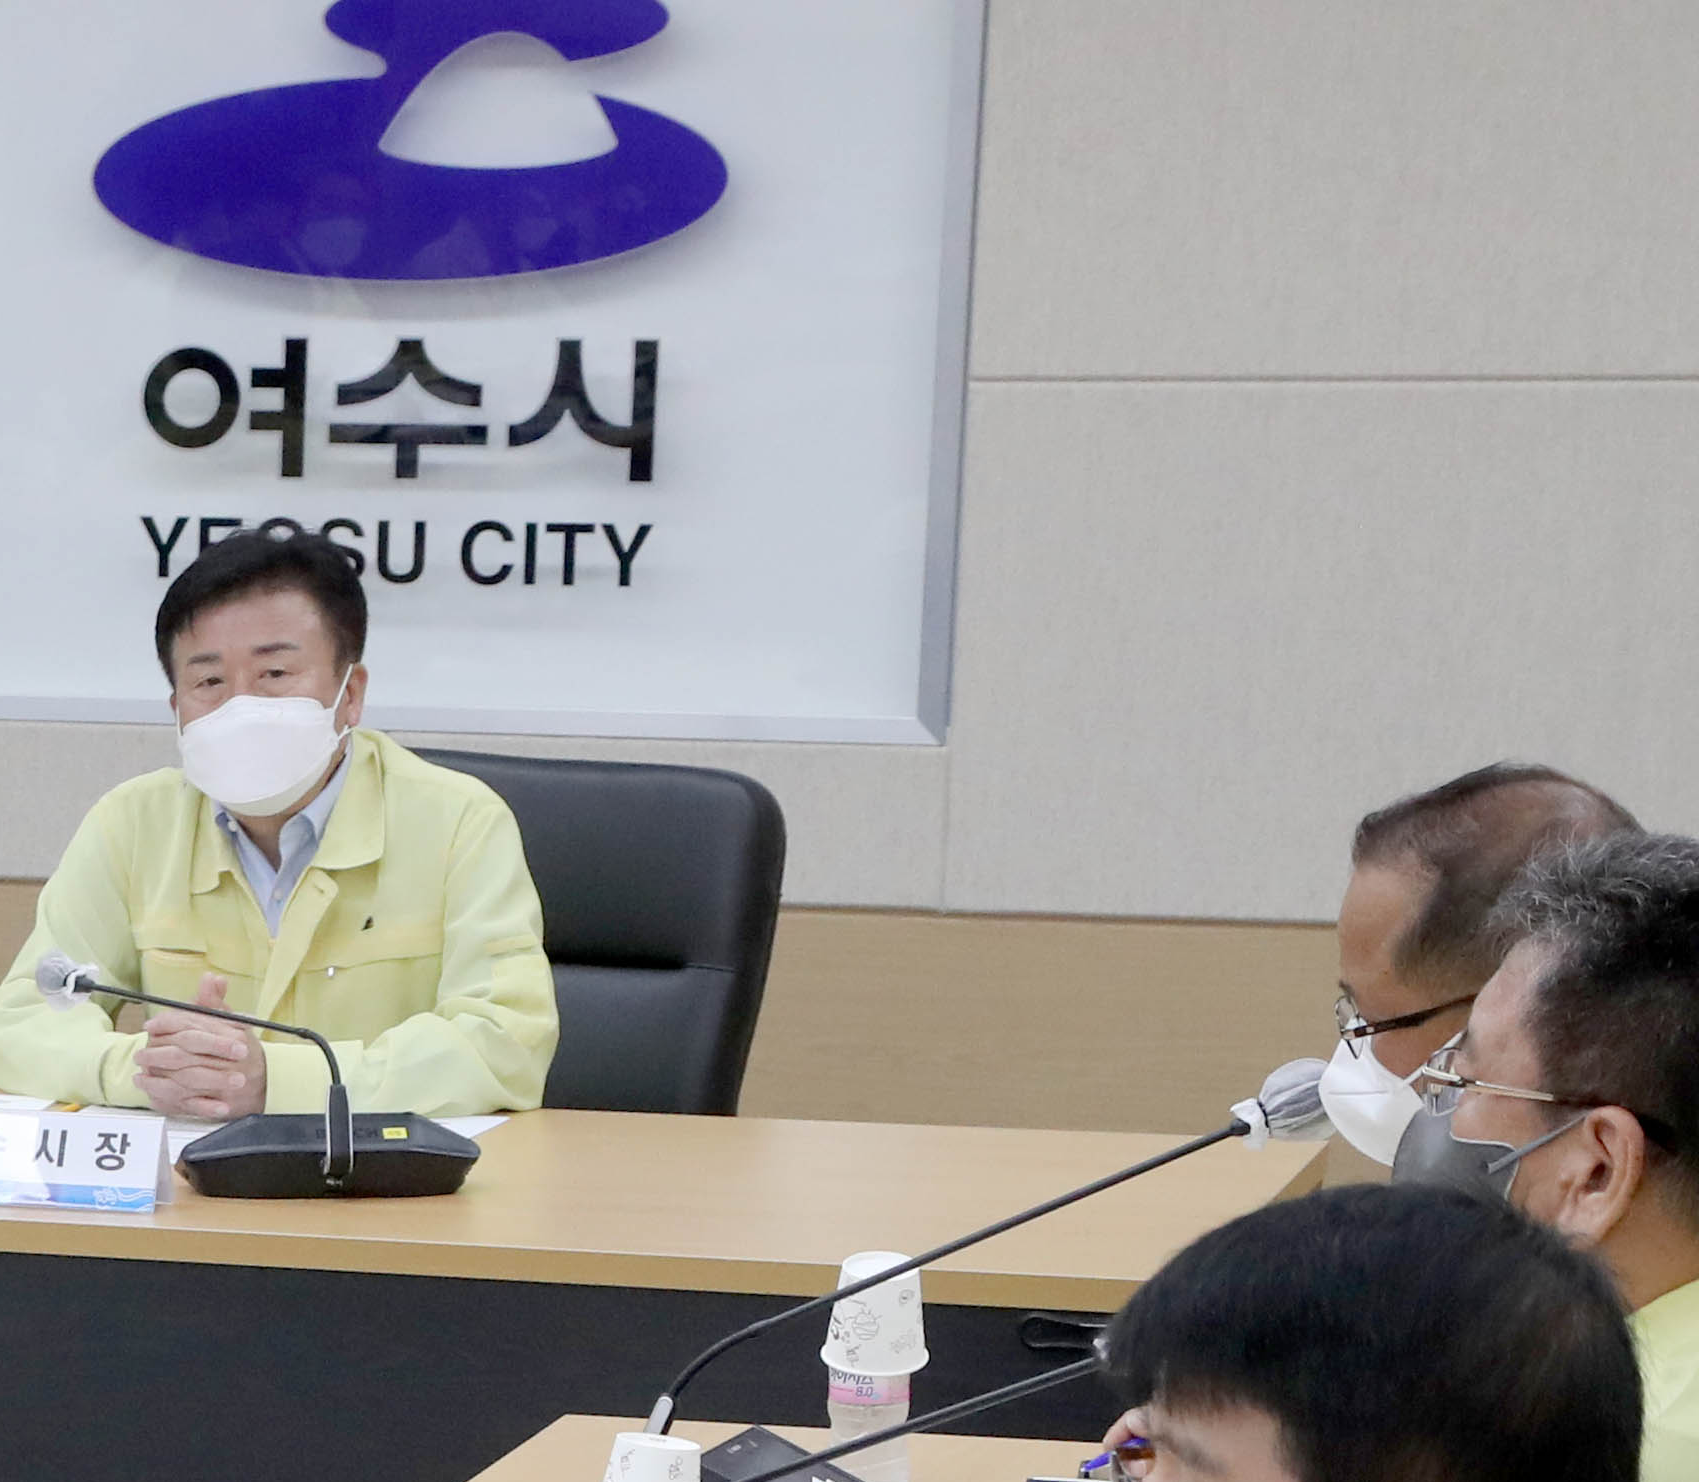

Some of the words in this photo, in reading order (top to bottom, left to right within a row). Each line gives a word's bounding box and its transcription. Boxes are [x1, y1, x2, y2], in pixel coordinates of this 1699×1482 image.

[143, 337, 660, 482] 여수시
[141, 516, 427, 584] YSU
[460, 519, 654, 587] CITY
